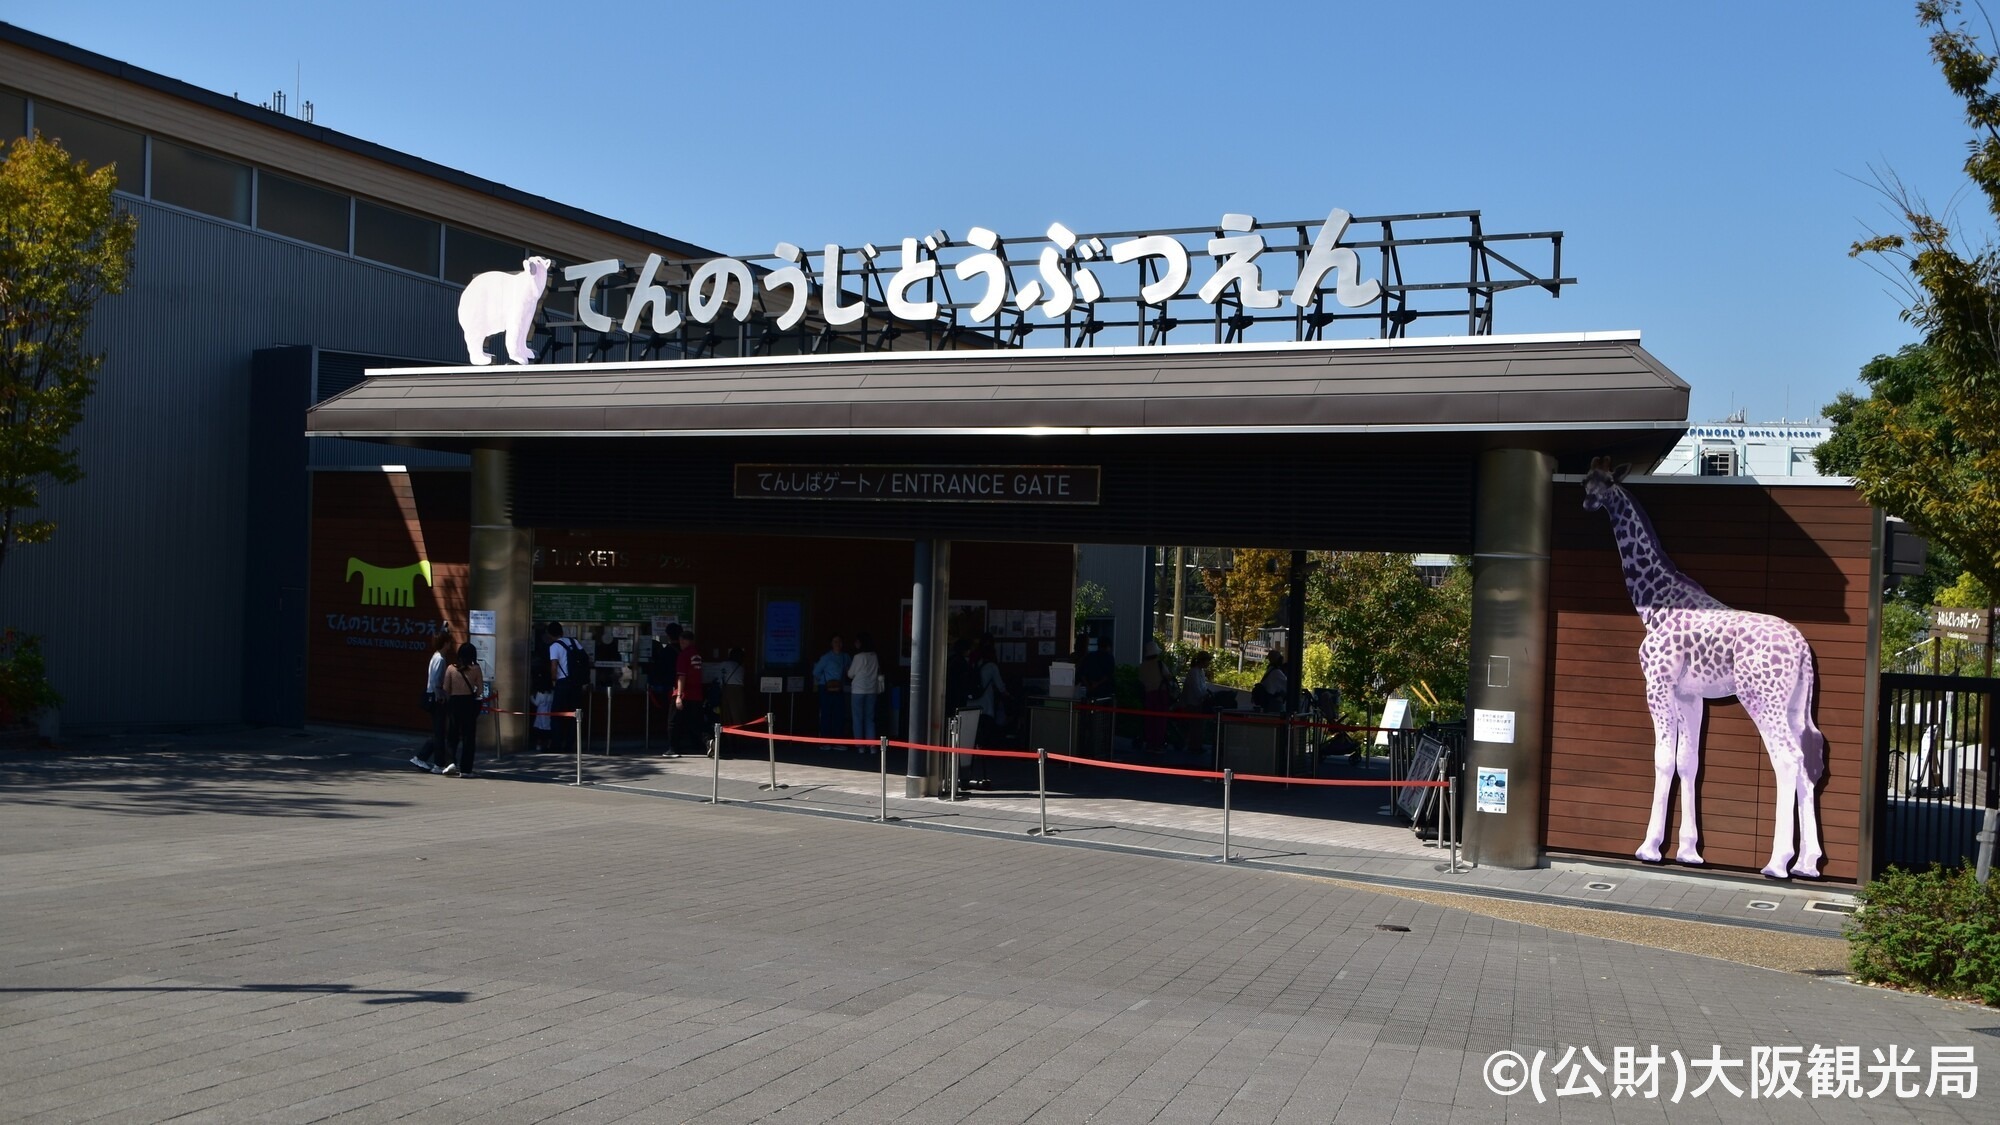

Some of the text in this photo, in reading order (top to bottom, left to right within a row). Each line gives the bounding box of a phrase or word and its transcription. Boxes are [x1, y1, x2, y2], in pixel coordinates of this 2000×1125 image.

[565, 207, 1382, 335] てんのうじどうぶつえん
[758, 472, 1071, 496] てんしばゲート / ENTRANCE GATE
[346, 636, 427, 651] OSAKA TENNOJI ZOO
